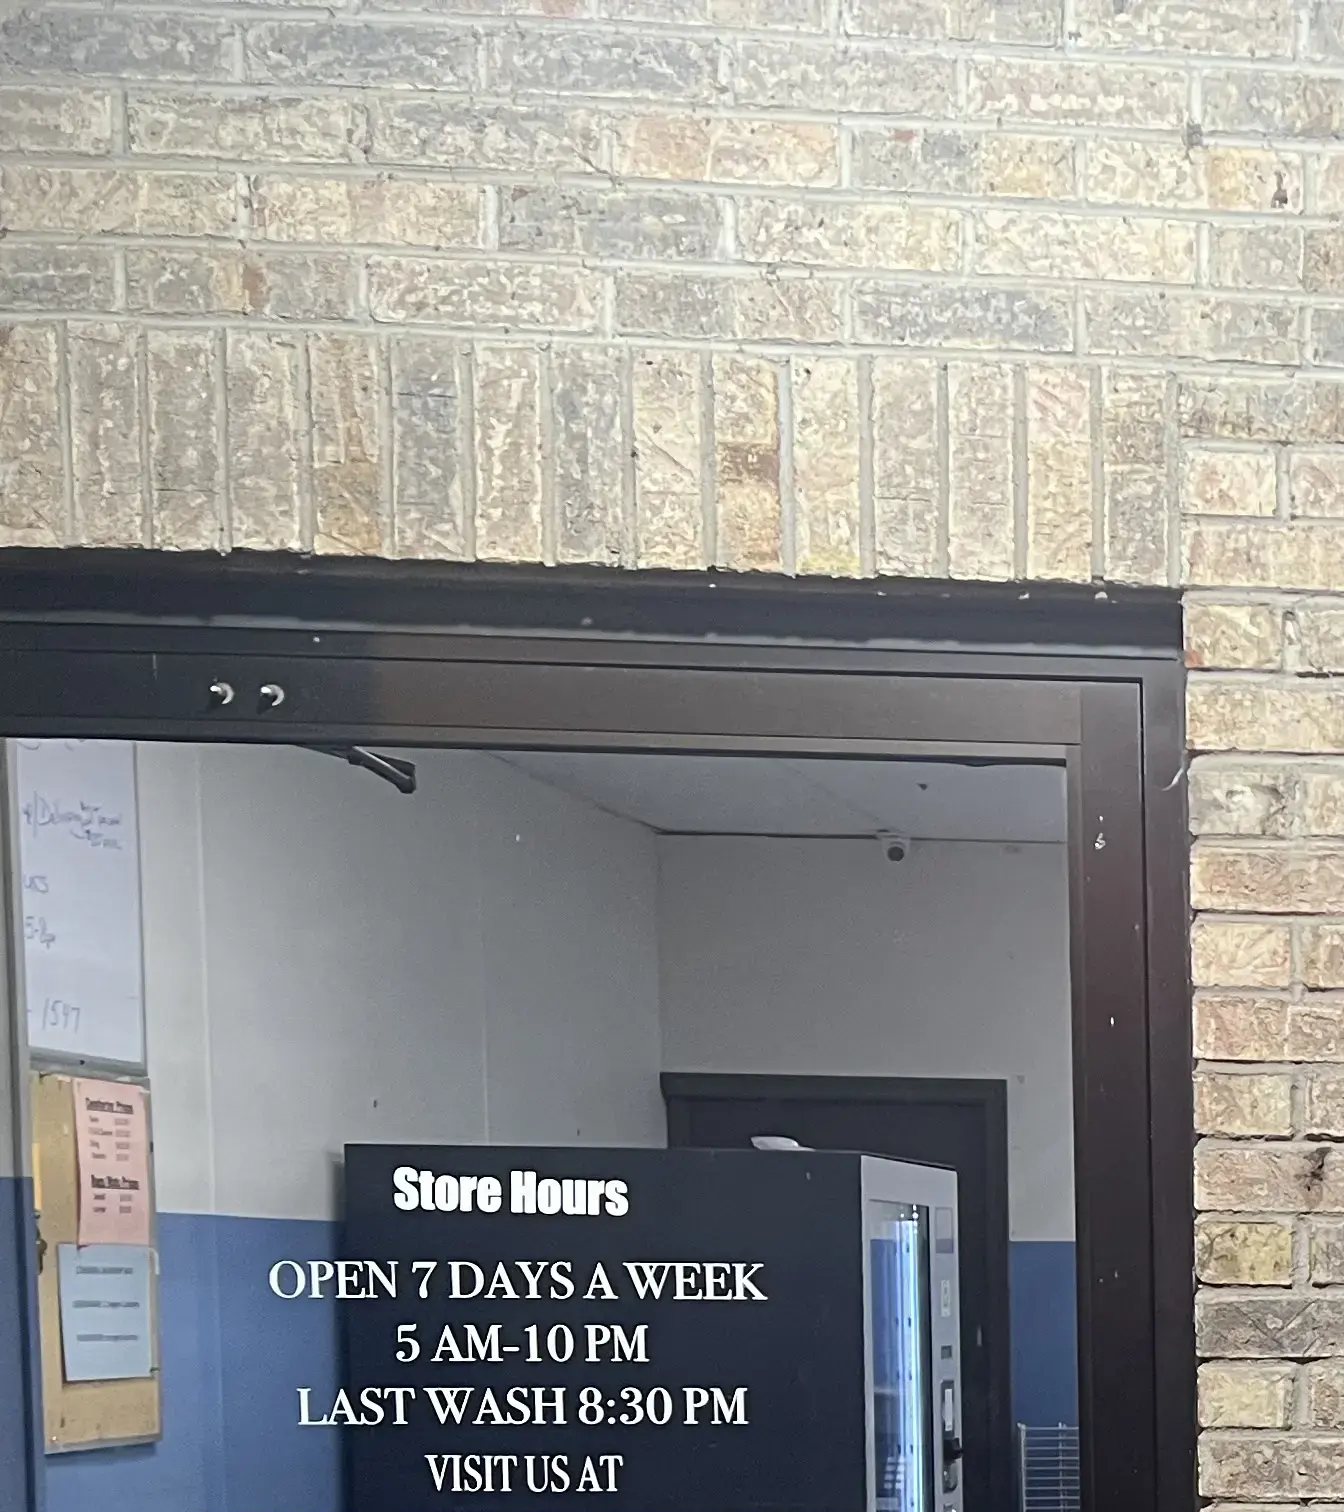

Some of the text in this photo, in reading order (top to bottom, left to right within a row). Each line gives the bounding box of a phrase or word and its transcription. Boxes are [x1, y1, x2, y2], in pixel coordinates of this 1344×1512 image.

[392, 1166, 630, 1217] Store Hours
[268, 1260, 769, 1302] OPEN 7 DAYS A WEEK
[396, 1323, 651, 1363] 5 AM-10 PM
[296, 1386, 750, 1425] LAST WASH 8:30 PM
[424, 1454, 625, 1493] VISIT US AT
